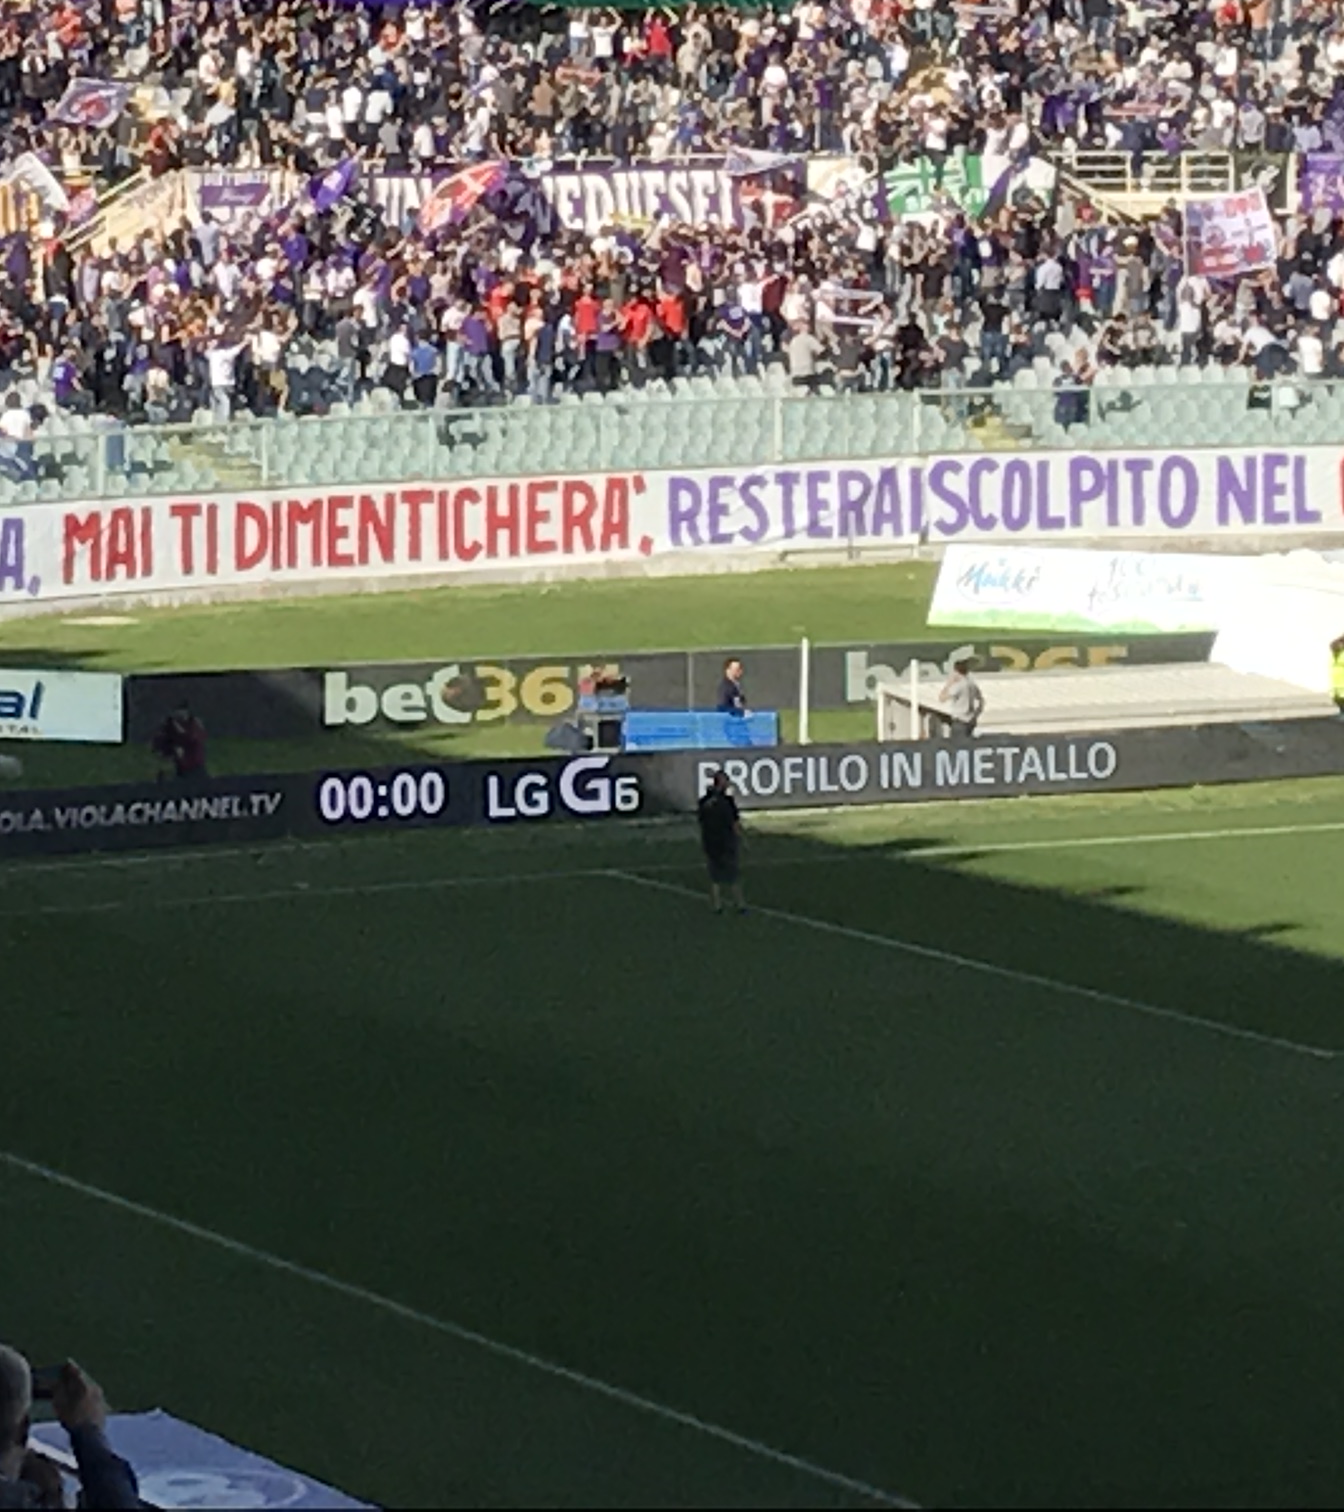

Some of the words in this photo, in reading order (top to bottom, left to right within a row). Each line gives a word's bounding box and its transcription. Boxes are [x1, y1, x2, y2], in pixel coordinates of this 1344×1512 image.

[62, 505, 153, 585] MAI
[170, 503, 219, 577] TI
[668, 466, 923, 547] RESTERAI
[928, 454, 1200, 534] SCOLPITO
[1216, 453, 1322, 527] NEL
[319, 771, 445, 821] 00:00
[487, 774, 549, 819] LG
[559, 756, 641, 815] G6
[697, 752, 867, 800] PROFILO
[880, 751, 924, 789] IN
[934, 740, 1118, 786] METALLO
